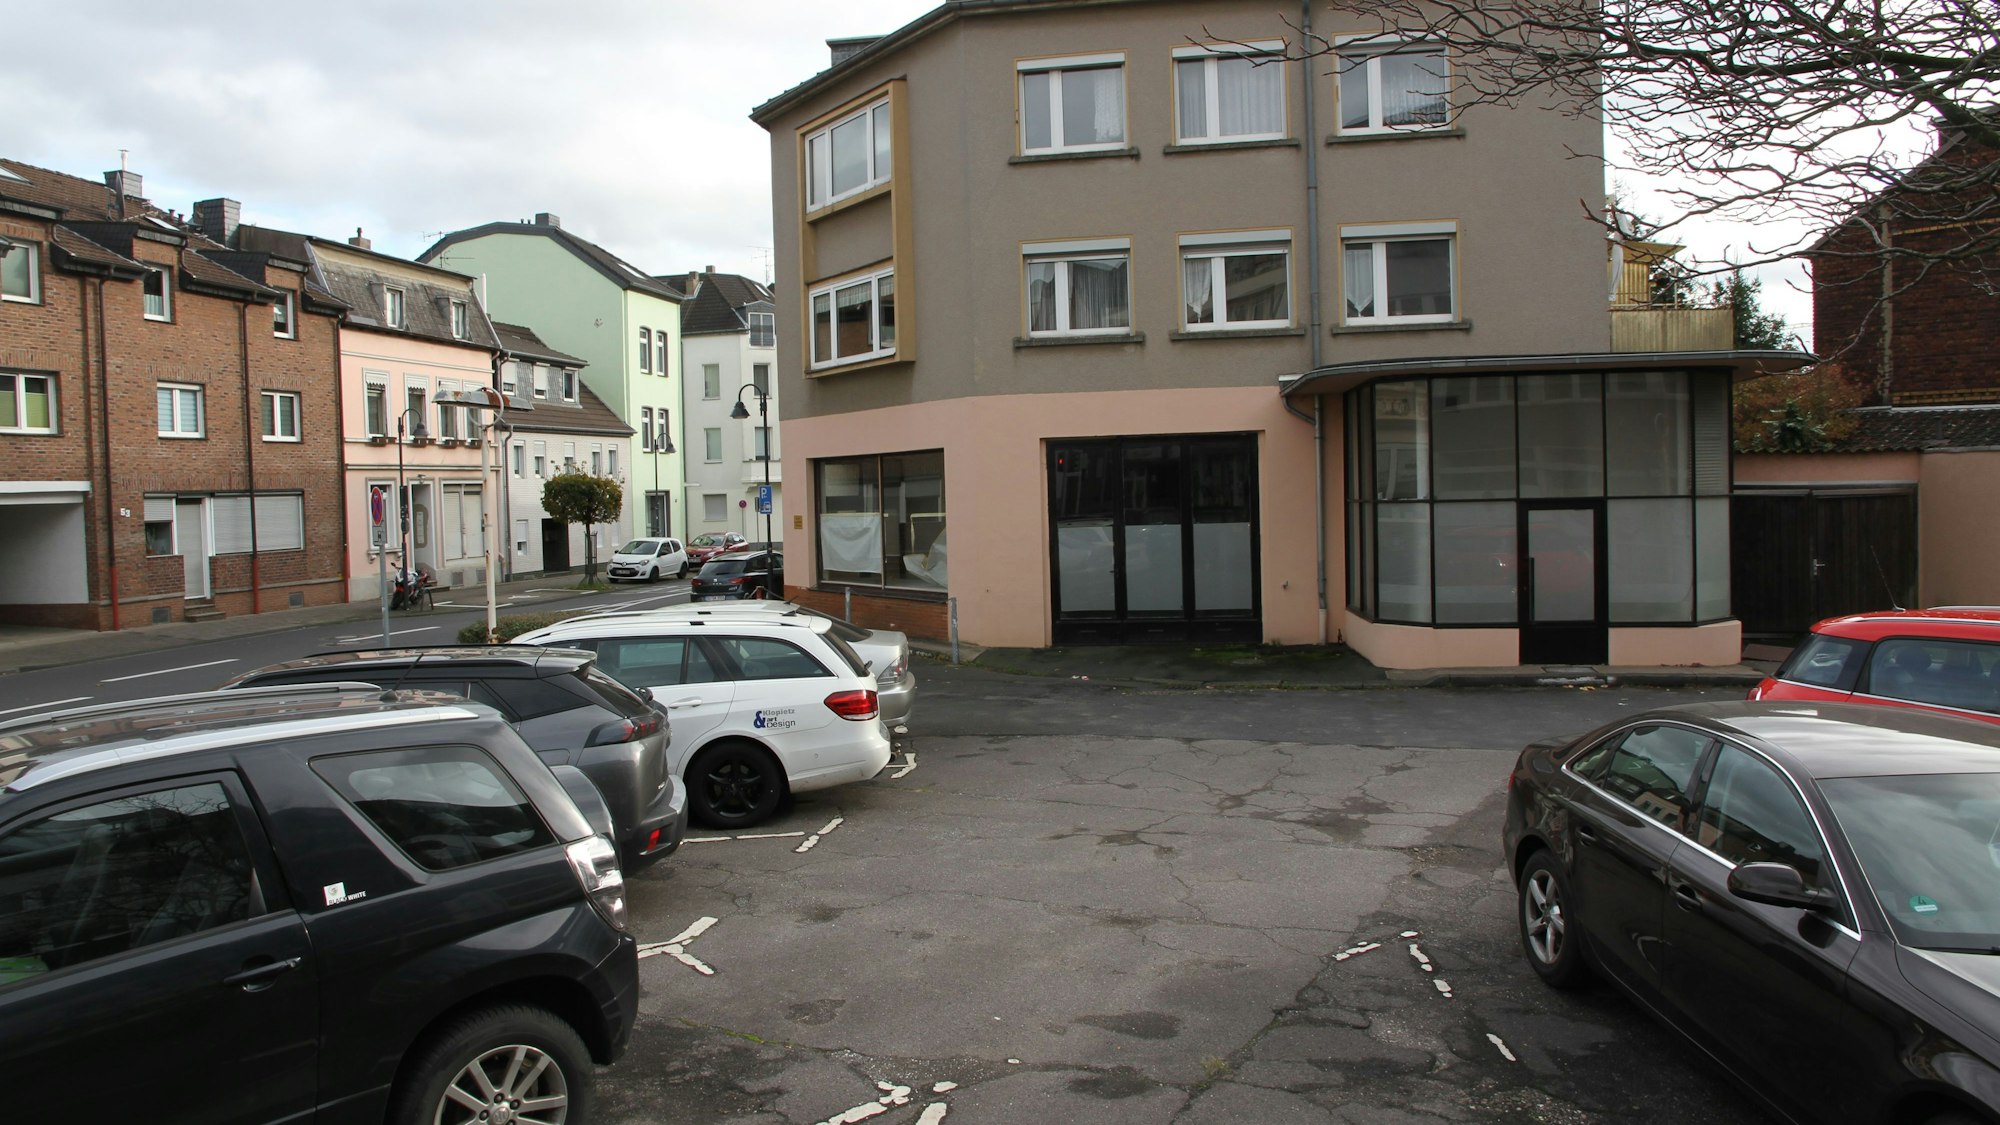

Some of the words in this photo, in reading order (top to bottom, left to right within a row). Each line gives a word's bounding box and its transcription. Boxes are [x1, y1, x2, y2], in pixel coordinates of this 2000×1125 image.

[761, 487, 767, 499] P
[766, 719, 796, 729] Design
[347, 891, 366, 901] WHITE
